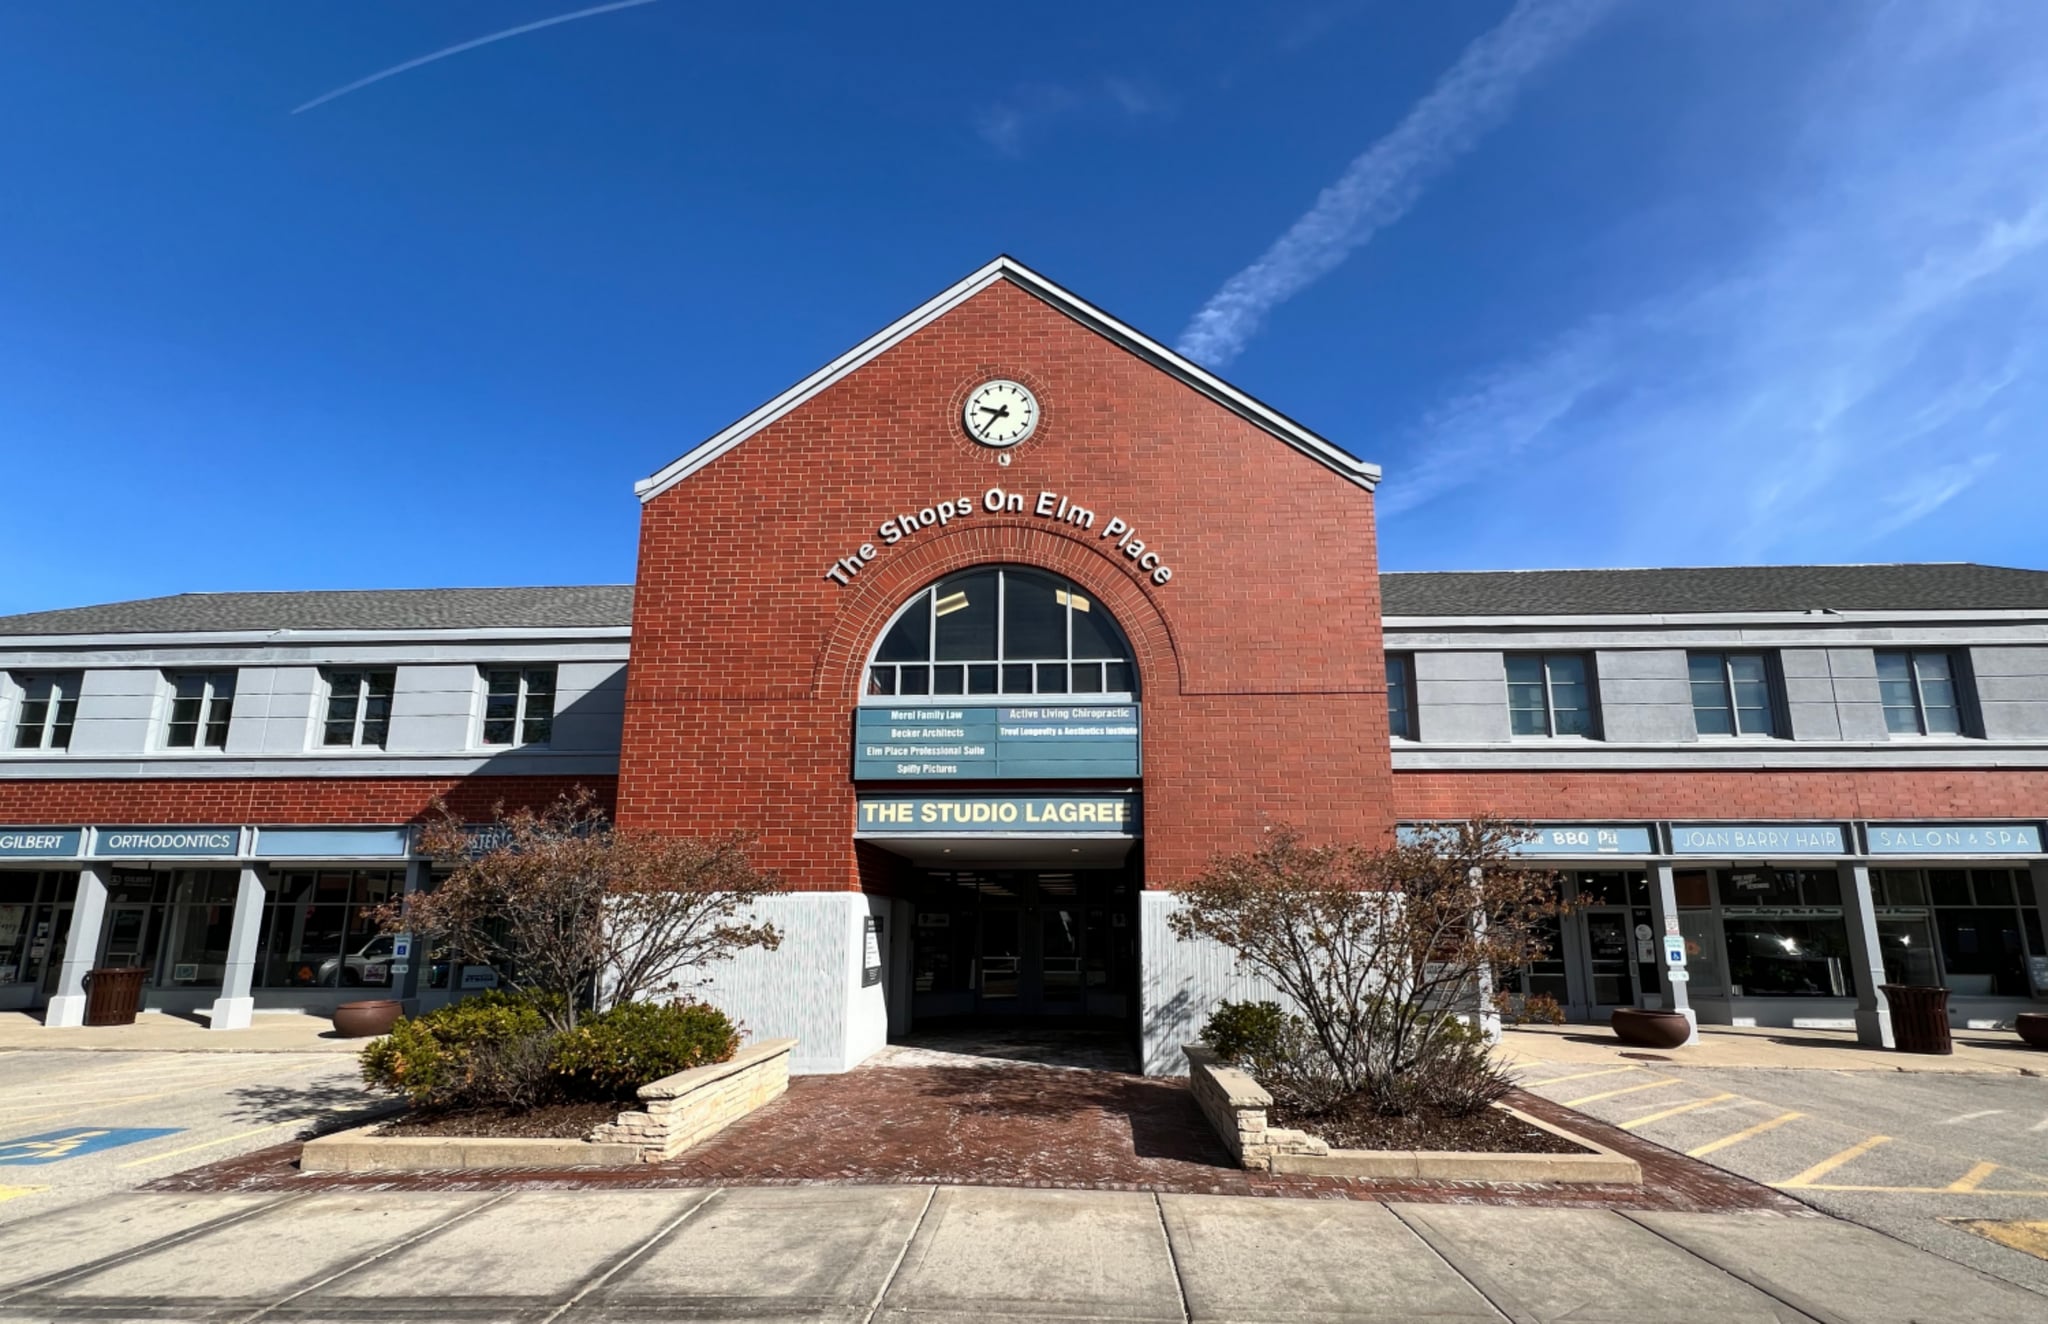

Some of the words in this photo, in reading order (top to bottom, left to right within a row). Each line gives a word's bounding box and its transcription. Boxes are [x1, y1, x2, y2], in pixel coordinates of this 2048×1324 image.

[824, 542, 878, 586] The
[878, 496, 973, 546] Shops
[983, 487, 1024, 513] On
[1035, 490, 1095, 530] Elm
[1101, 516, 1174, 586] Place
[917, 711, 945, 721] Family
[946, 711, 963, 720] Law
[1009, 709, 1039, 719] Active
[1041, 709, 1069, 719] Living
[1072, 708, 1130, 719] Chiropractic
[891, 729, 920, 738] Becker
[922, 728, 964, 737] Architects
[867, 747, 882, 756] Elm
[884, 747, 908, 756] Place
[910, 746, 962, 755] Professional
[963, 746, 985, 755] Suite
[923, 764, 957, 773] Pictures
[862, 803, 913, 822] THE
[921, 803, 1018, 823] STUDIO
[1025, 803, 1131, 822] LAGREE
[0, 835, 64, 849] GILBERT
[109, 834, 231, 849] ORTHODONTICS
[1552, 831, 1589, 846] BBQ
[1597, 831, 1619, 845] Pit
[1683, 832, 1729, 848] JOAN
[1735, 832, 1790, 848] BARRY
[1796, 832, 1836, 847] HAIR
[1881, 831, 1961, 847] SALON
[1969, 833, 1978, 844] &
[1985, 831, 2030, 846] SPA
